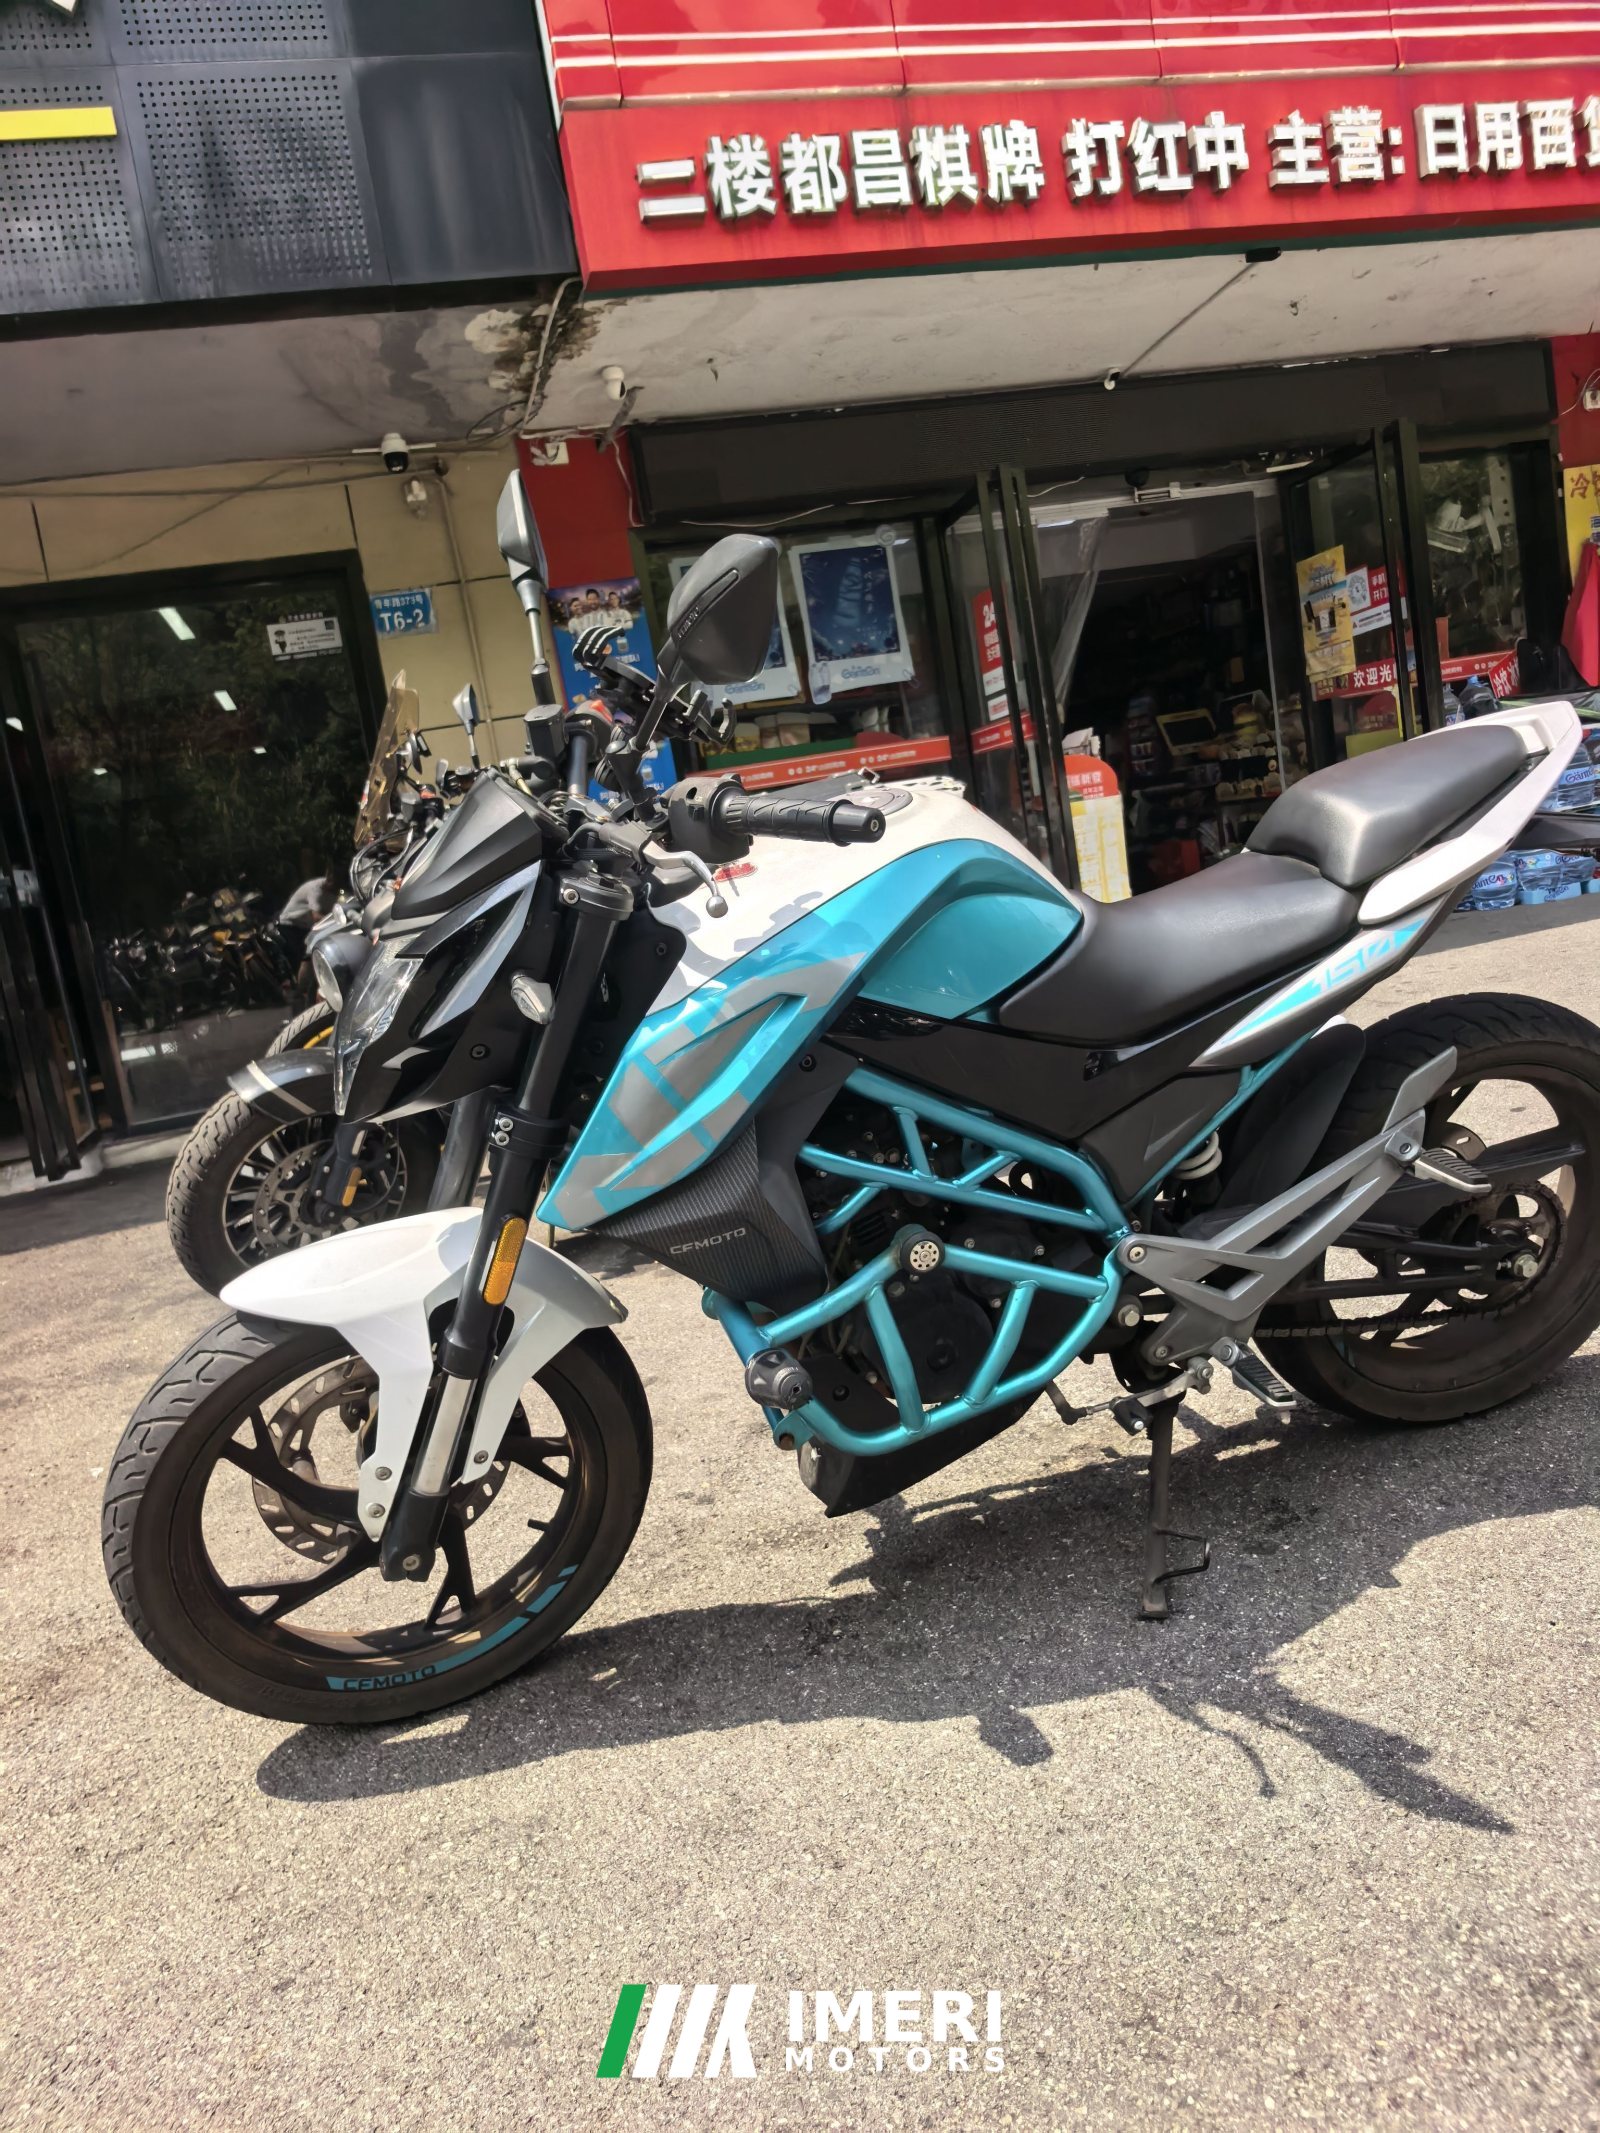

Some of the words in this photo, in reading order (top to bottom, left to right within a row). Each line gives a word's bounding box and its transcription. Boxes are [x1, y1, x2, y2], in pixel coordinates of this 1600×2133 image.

[636, 119, 1045, 224] 二楼都昌棋牌
[1063, 110, 1250, 200] 打红中
[379, 608, 426, 633] T6-2
[1353, 663, 1397, 688] 欢迎光
[669, 1227, 747, 1255] CFMOTO
[343, 1664, 437, 1691] CFMOTO
